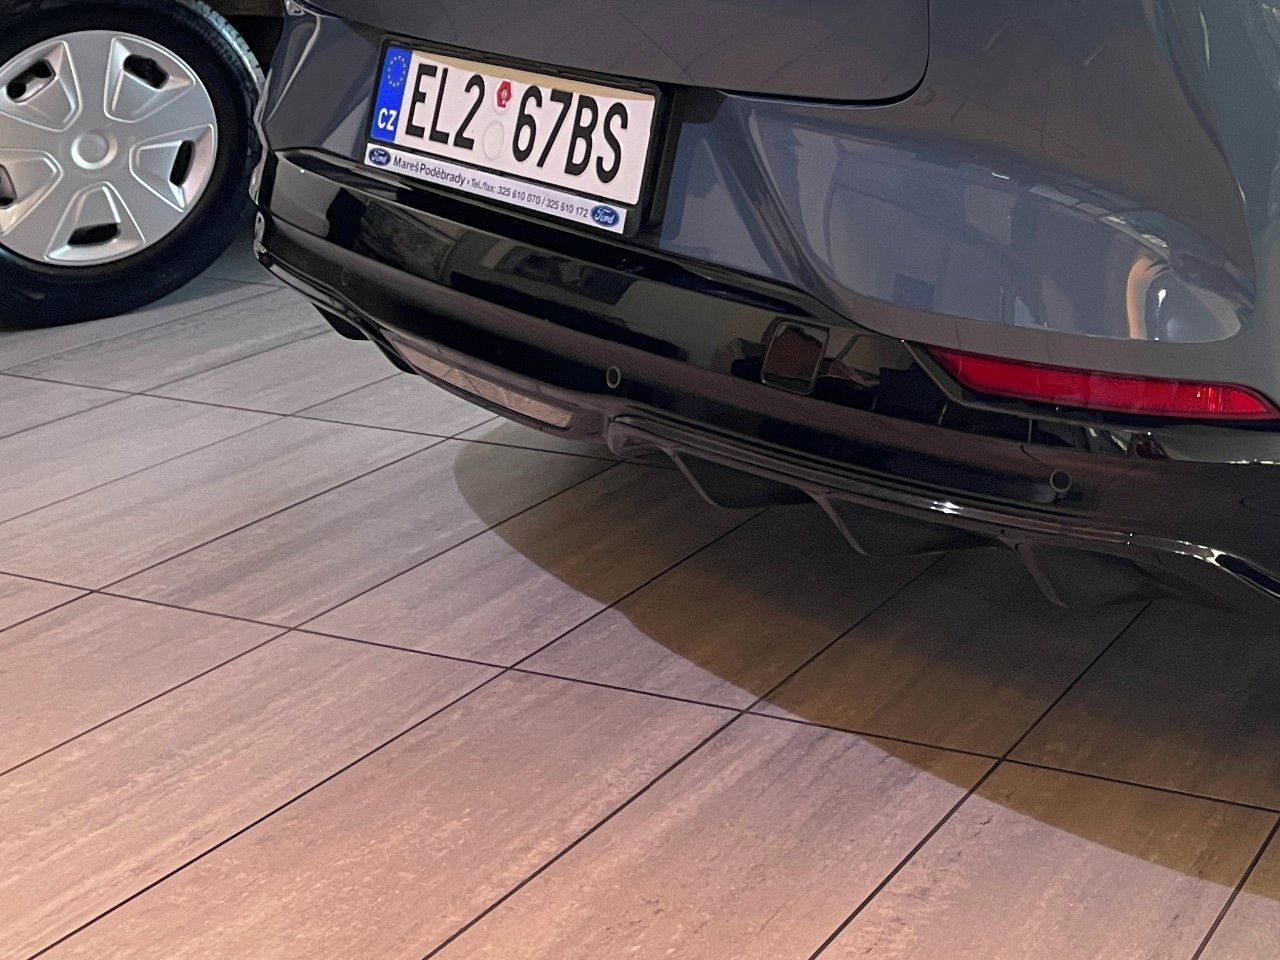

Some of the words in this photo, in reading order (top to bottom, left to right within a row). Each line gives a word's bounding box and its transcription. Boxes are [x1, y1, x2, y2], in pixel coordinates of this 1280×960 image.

[377, 107, 398, 131] CZ
[405, 63, 485, 150] EL2
[512, 85, 629, 183] 67BS
[497, 185, 511, 197] 325
[527, 194, 541, 205] 070
[545, 198, 559, 210] 325
[575, 206, 589, 218] 172
[594, 208, 616, 225] Ford
